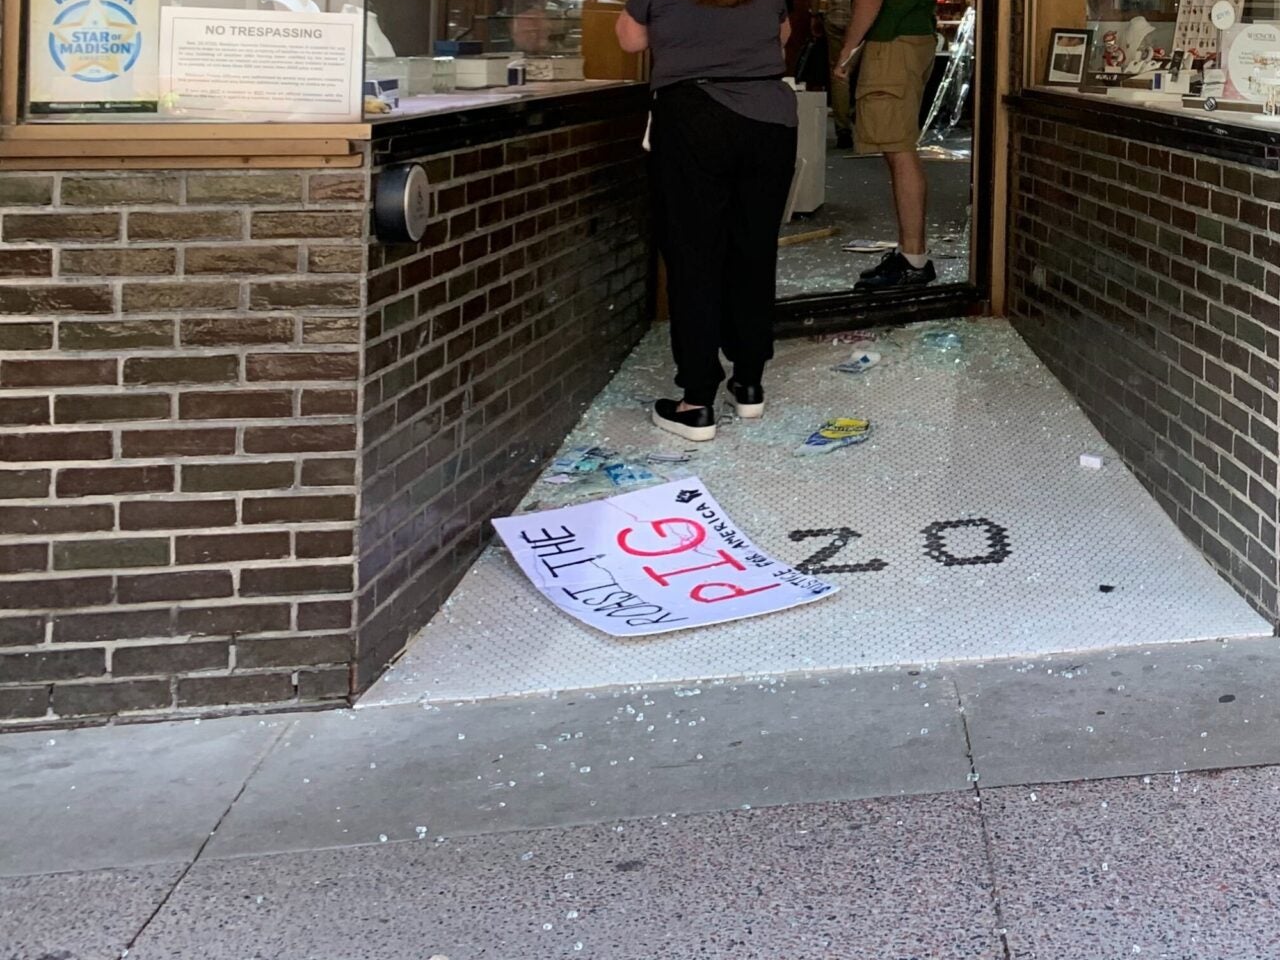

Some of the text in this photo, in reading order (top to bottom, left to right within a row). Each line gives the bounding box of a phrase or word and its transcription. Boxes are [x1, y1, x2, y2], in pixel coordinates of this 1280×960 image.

[60, 42, 132, 54] MADISON
[71, 31, 110, 43] STAR
[204, 24, 323, 39] NO TRESPASSING
[617, 517, 781, 603] PIG
[696, 501, 832, 594] JUSTICE FOR AMERICA
[519, 524, 689, 627] ROAST THE
